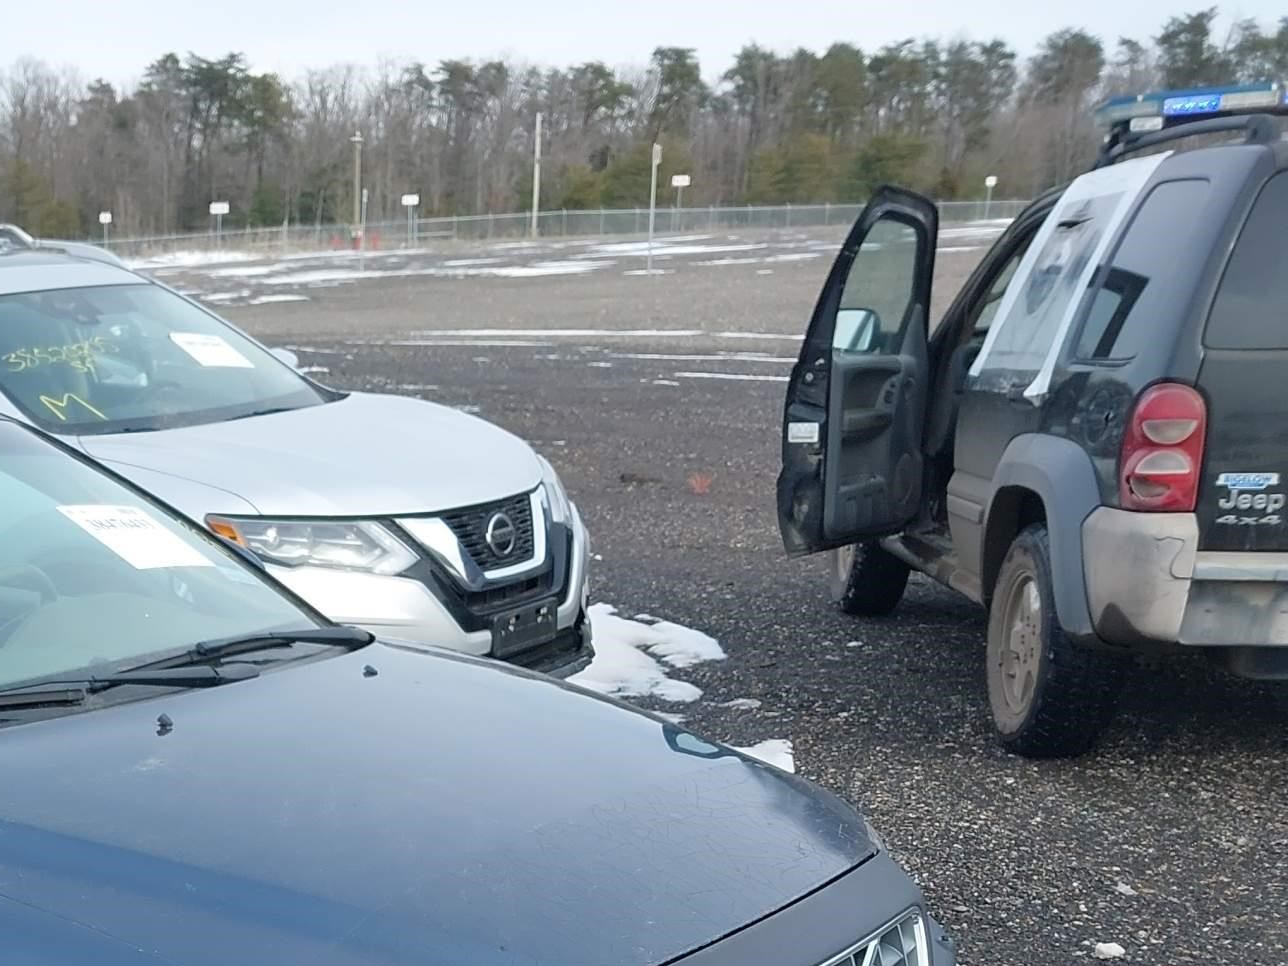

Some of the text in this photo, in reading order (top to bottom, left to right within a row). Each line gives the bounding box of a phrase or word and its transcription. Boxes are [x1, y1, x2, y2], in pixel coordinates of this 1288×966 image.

[39, 392, 109, 421] M
[1218, 489, 1286, 513] Jeep
[1215, 514, 1282, 526] 4x4
